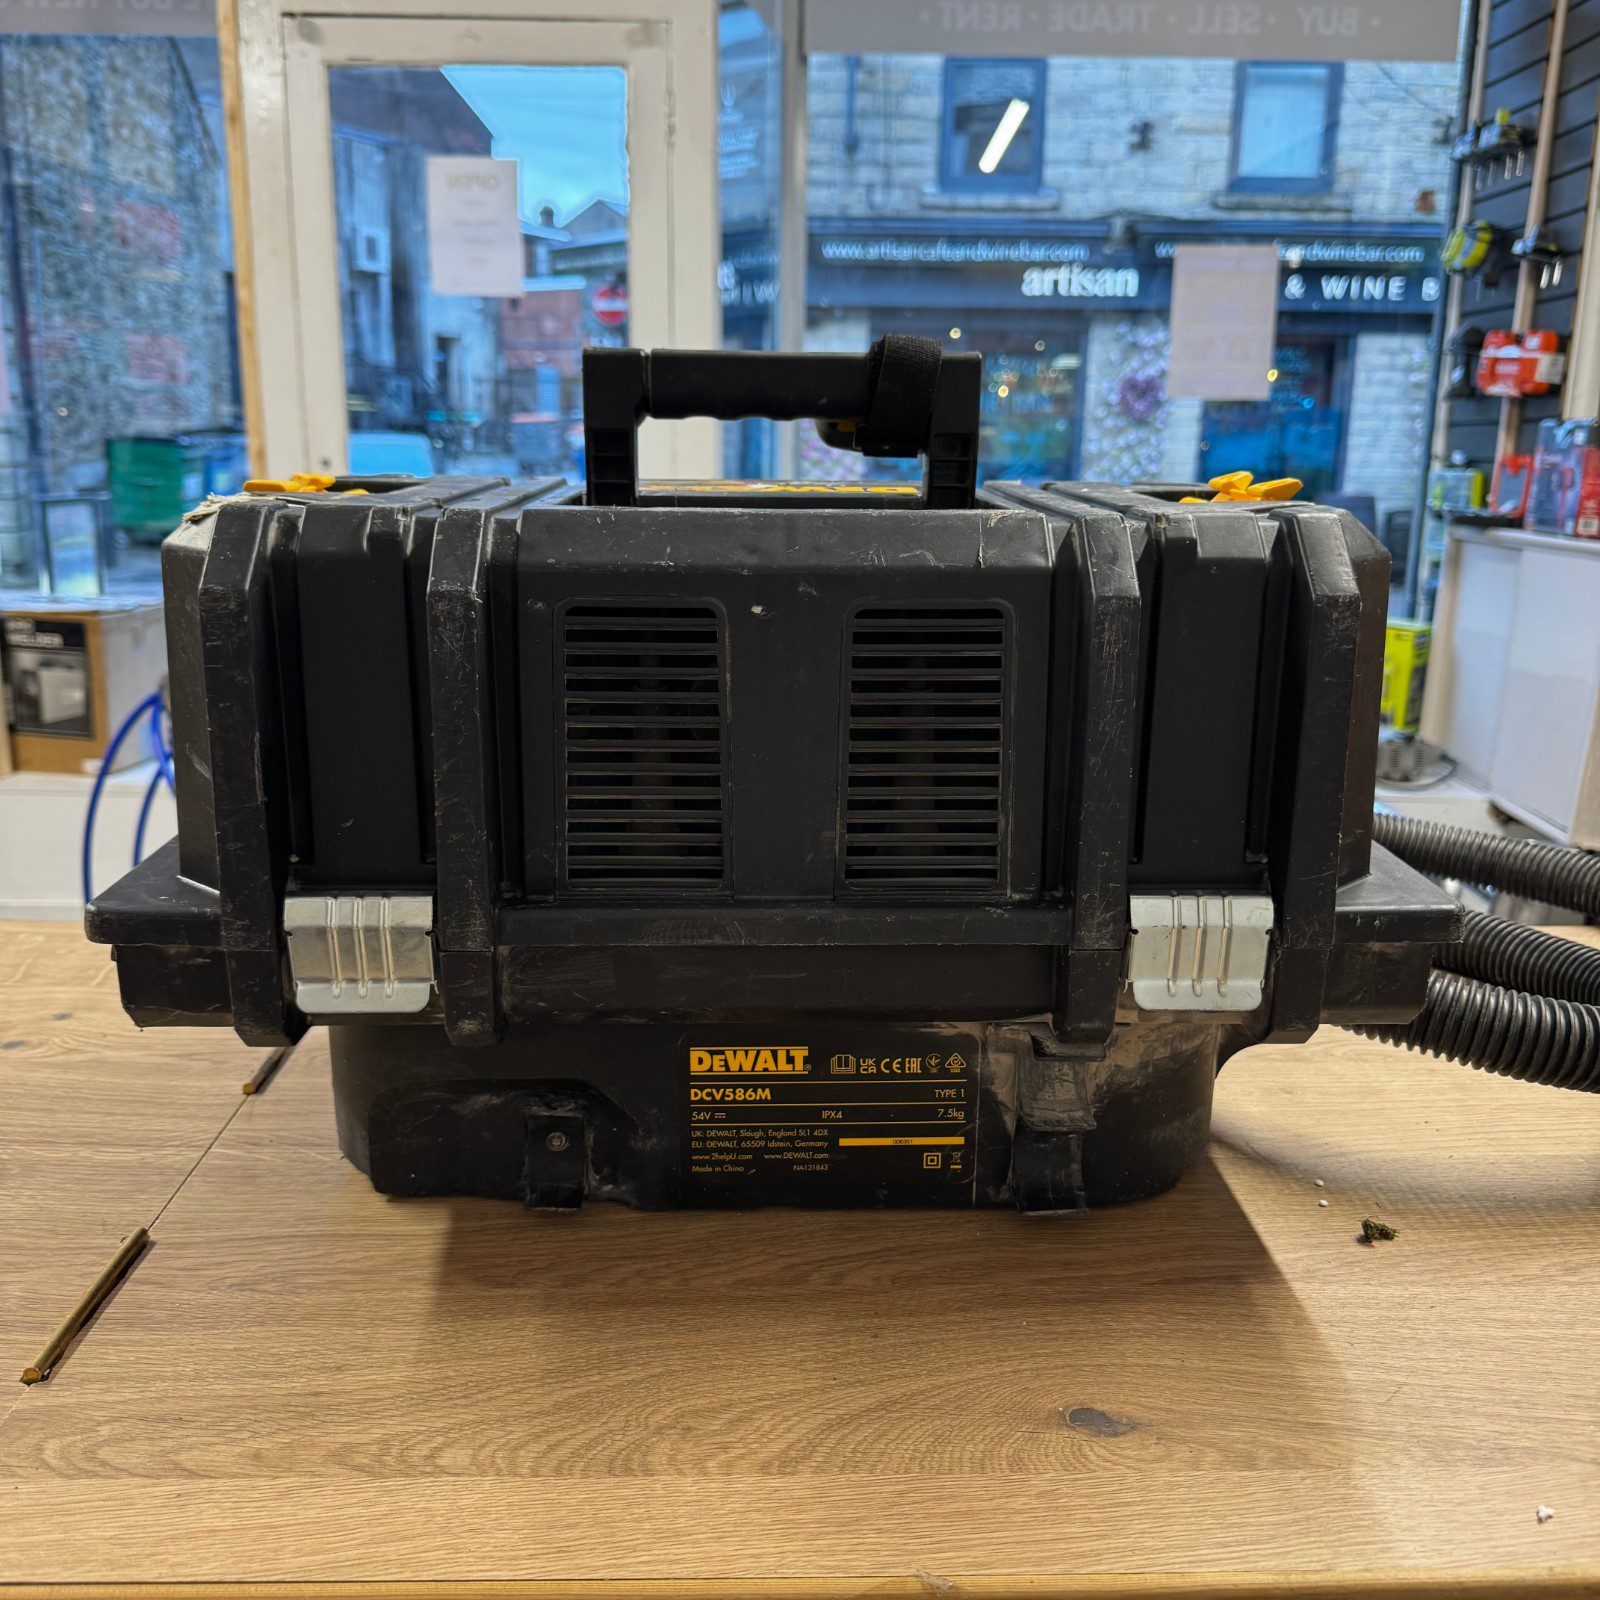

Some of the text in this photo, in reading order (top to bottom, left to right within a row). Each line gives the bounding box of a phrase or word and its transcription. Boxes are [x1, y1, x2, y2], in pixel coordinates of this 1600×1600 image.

[1021, 262, 1140, 298] artisan
[1284, 273, 1306, 300] &
[1320, 275, 1408, 301] WINE
[690, 1088, 771, 1101] DCV586M
[934, 1089, 957, 1098] TYPE
[691, 1111, 712, 1121] 54V
[821, 1110, 843, 1119] IPX4
[937, 1108, 965, 1120] 7.5kg
[767, 1129, 797, 1139] England
[740, 1140, 765, 1148] 65509
[794, 1140, 829, 1149] Germany
[763, 1151, 829, 1159] www.DEWALT.com
[722, 1164, 745, 1172] China
